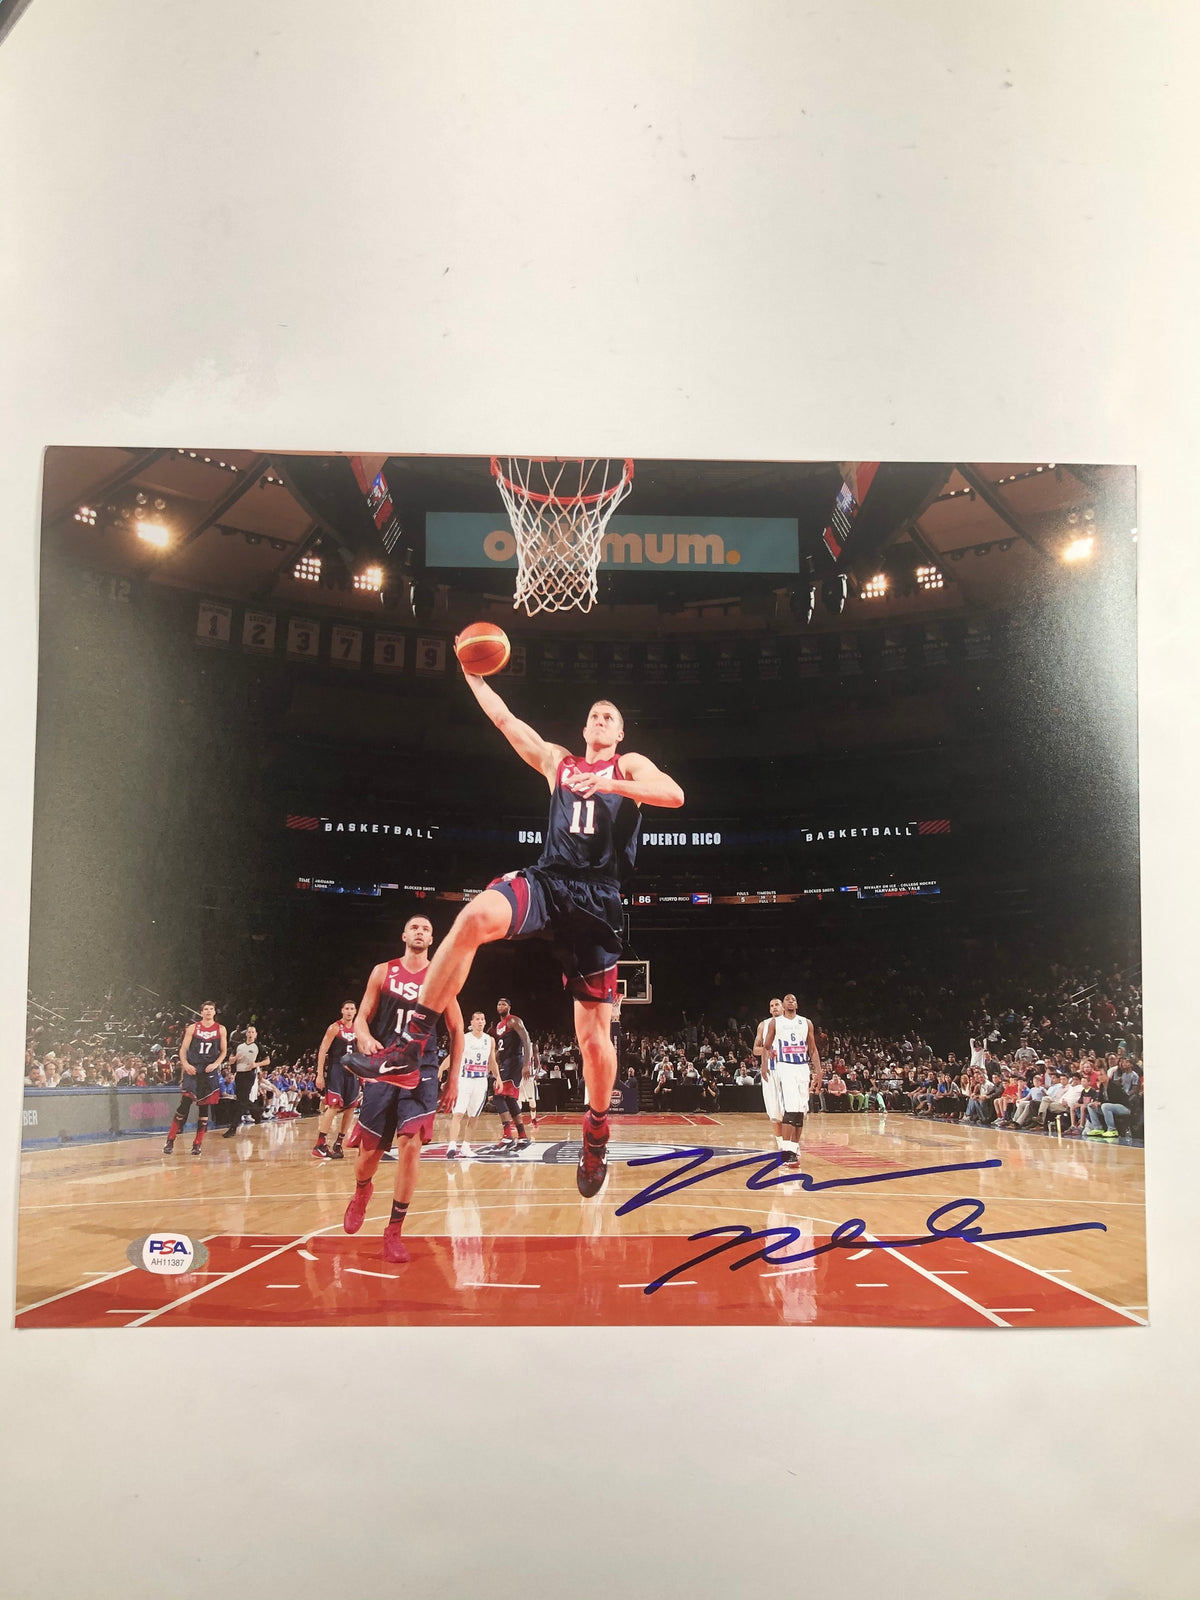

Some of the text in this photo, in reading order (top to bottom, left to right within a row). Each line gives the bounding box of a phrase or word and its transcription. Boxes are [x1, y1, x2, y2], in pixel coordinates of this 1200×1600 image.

[251, 624, 266, 645] 2
[296, 631, 310, 650] 3
[340, 638, 354, 658] 7
[383, 643, 396, 663] 9
[425, 648, 437, 667] 9
[570, 800, 595, 834] 11
[324, 822, 433, 840] BASKETBALL
[518, 831, 543, 844] USA
[806, 827, 912, 842] BASKETBALL
[642, 832, 721, 846] PUERTO RICO
[638, 895, 652, 904] 86
[390, 978, 425, 1000] US
[790, 1032, 797, 1042] 6
[199, 1042, 213, 1054] 17
[476, 1053, 482, 1061] 9
[23, 1110, 38, 1126] BER
[149, 1240, 188, 1255] PSA
[151, 1258, 185, 1267] AH11387
